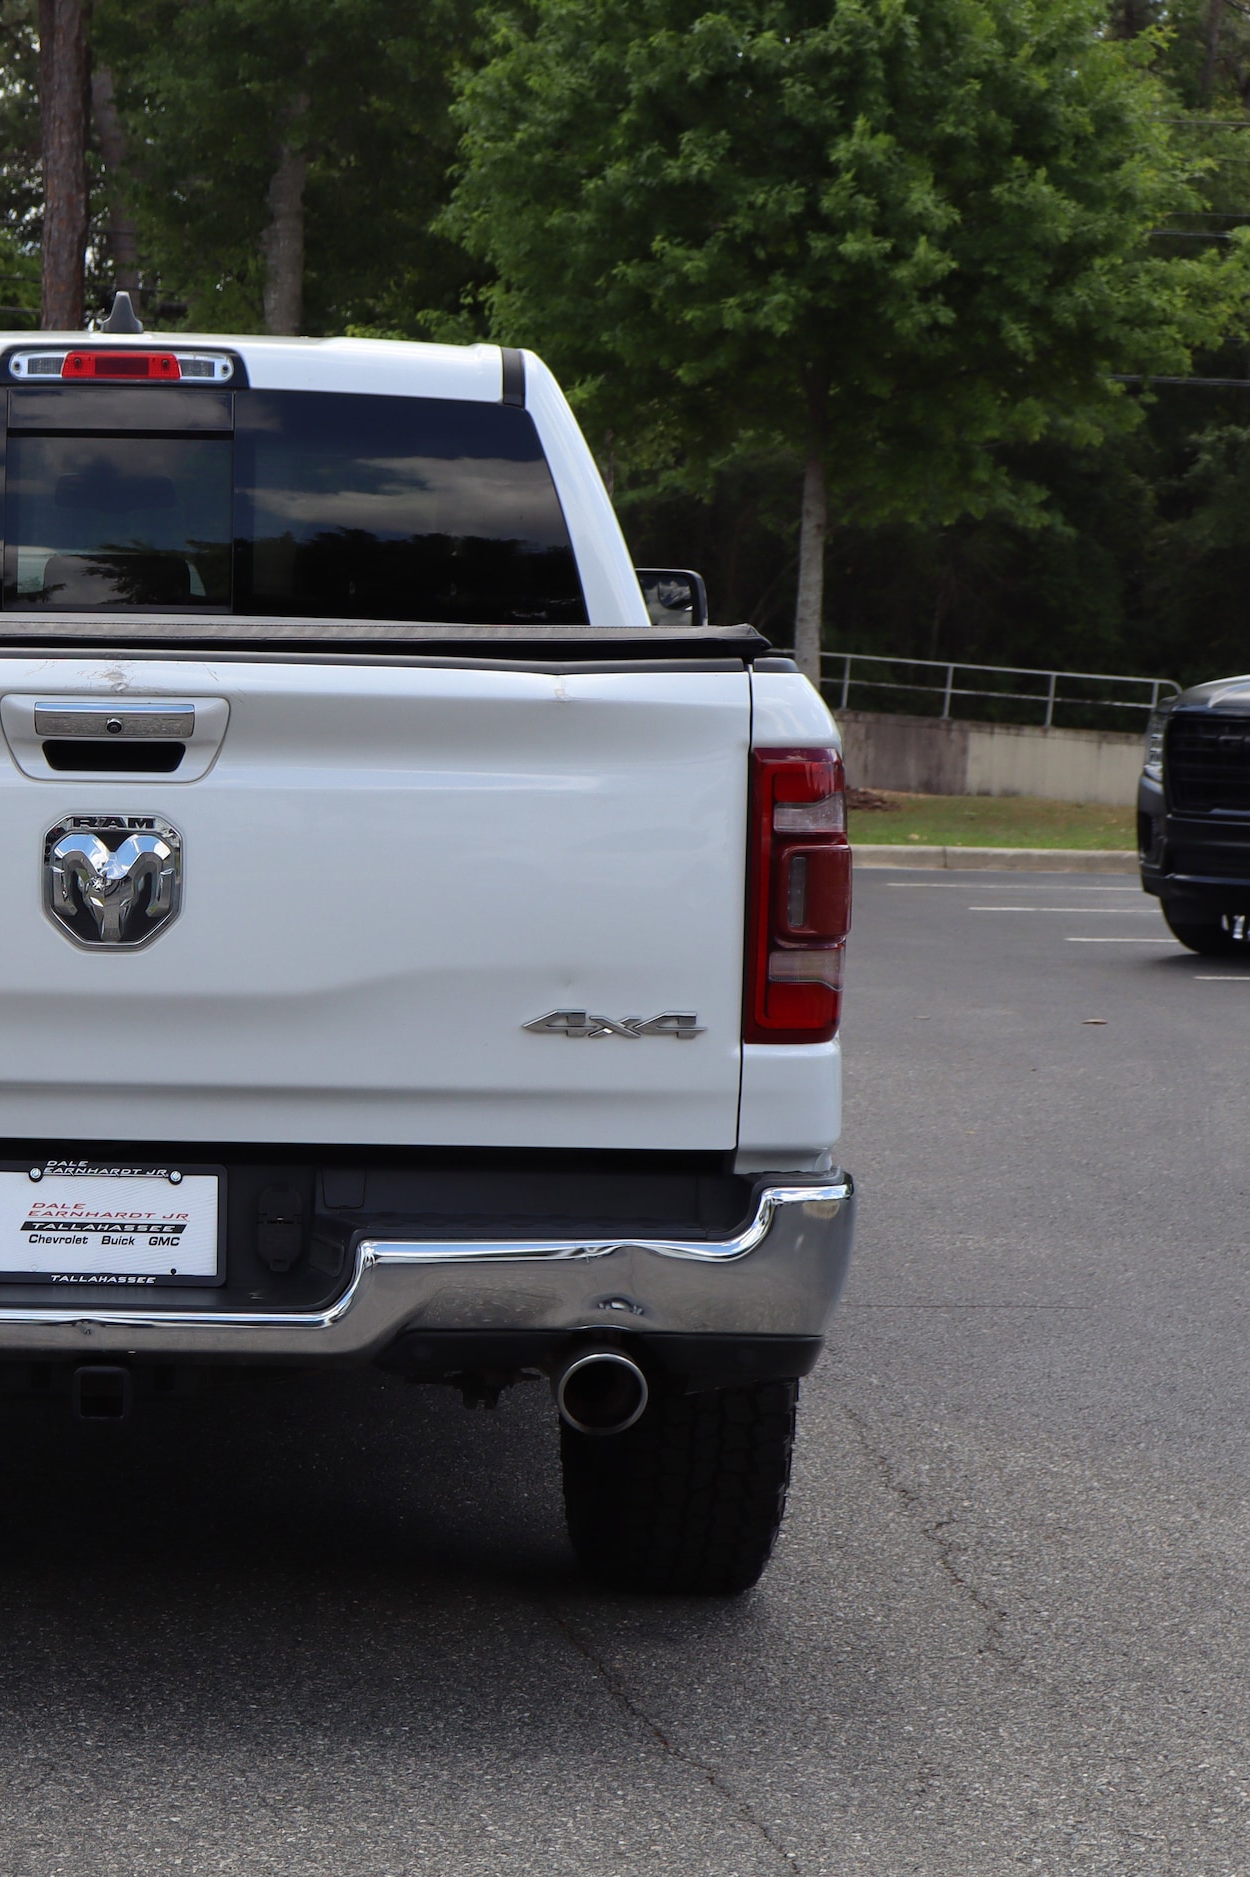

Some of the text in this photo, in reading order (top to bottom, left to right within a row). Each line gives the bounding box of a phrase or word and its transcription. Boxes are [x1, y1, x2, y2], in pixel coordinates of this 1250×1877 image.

[72, 816, 155, 830] RAM
[43, 1167, 141, 1176] EARNHARDT
[32, 1202, 86, 1210] DALE
[28, 1210, 190, 1221] EARNHARDT JR
[32, 1222, 176, 1232] TALLAHASSEE
[28, 1234, 180, 1247] Chevrolet Buick GMC
[50, 1275, 156, 1284] TALLAHASSEE
